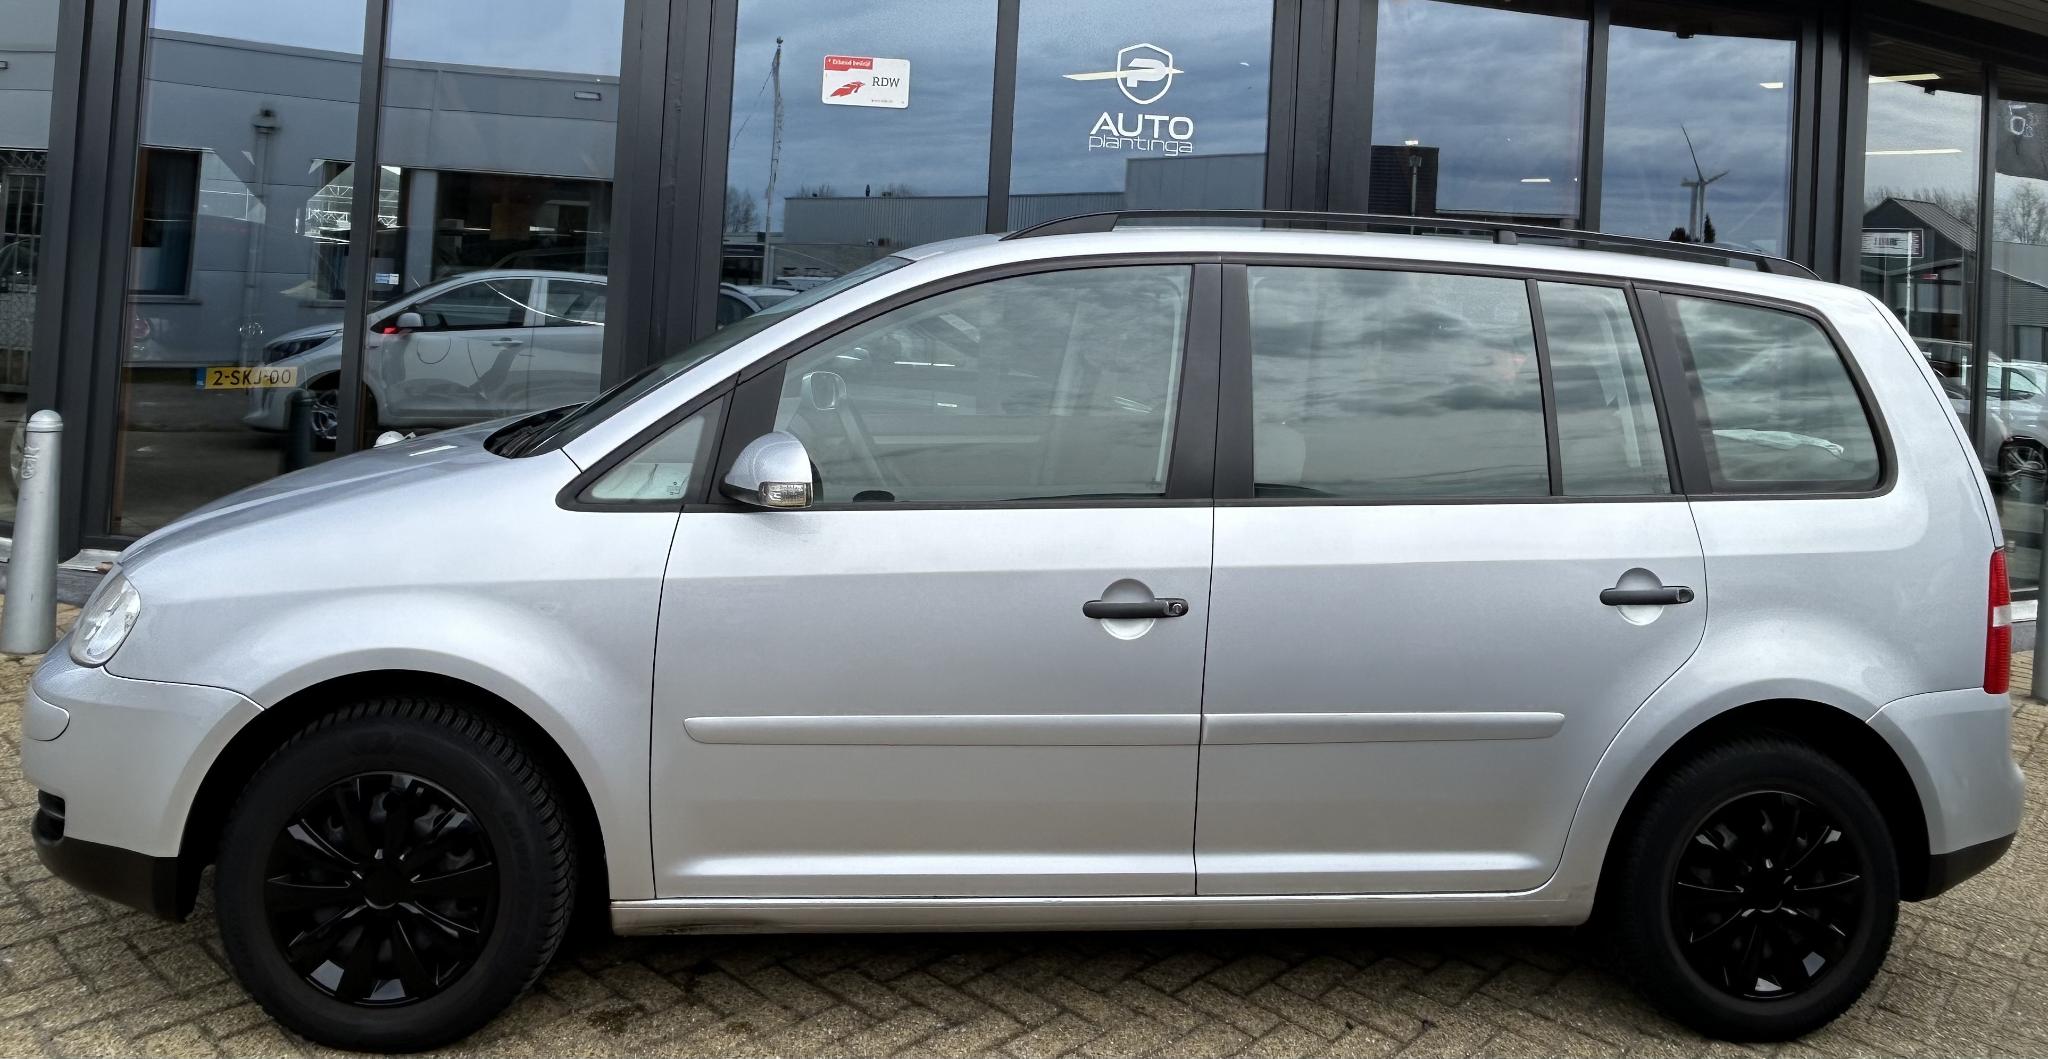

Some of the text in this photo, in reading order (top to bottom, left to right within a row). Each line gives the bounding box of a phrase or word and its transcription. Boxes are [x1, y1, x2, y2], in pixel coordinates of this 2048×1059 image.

[872, 76, 900, 87] RDW
[1089, 111, 1194, 140] AUTO
[1088, 134, 1193, 157] plantinga
[212, 369, 291, 386] 2-SKJ-00
